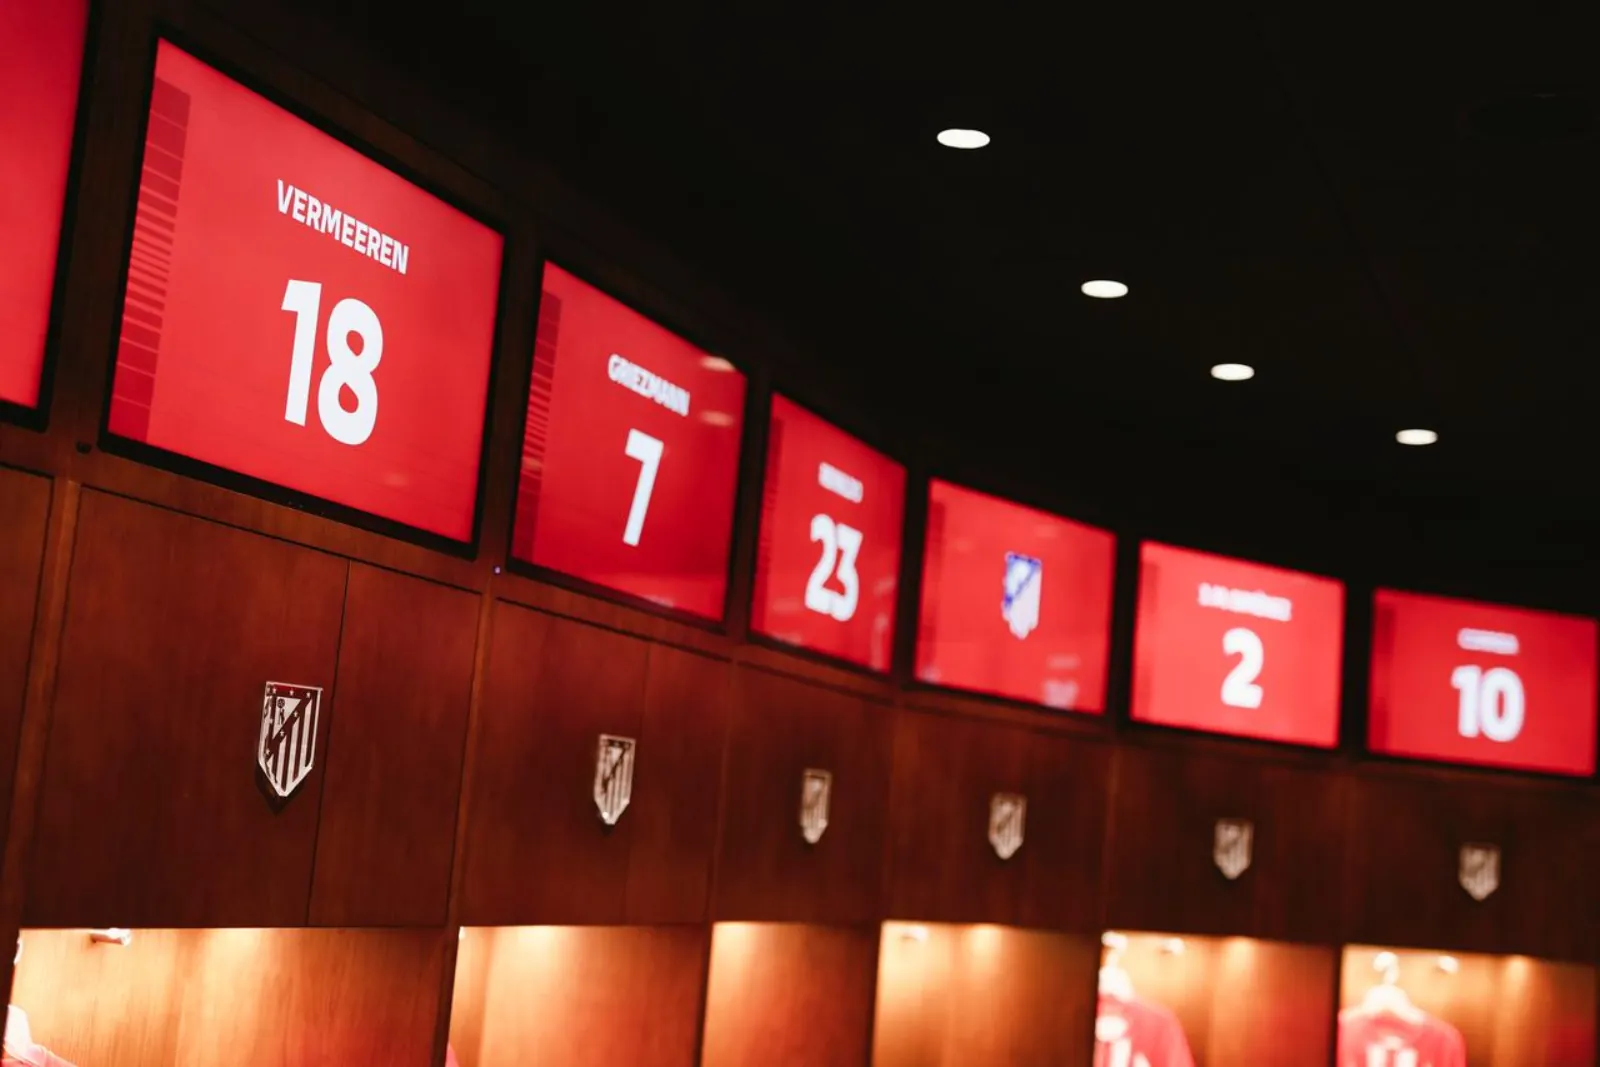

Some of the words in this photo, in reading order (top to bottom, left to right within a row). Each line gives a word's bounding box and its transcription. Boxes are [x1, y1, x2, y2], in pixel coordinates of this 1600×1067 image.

[277, 179, 409, 275] VERMEEREN
[280, 279, 385, 446] 18
[623, 428, 664, 547] 7
[804, 513, 863, 622] 23
[1220, 628, 1265, 710] 2
[1451, 665, 1525, 742] 10
